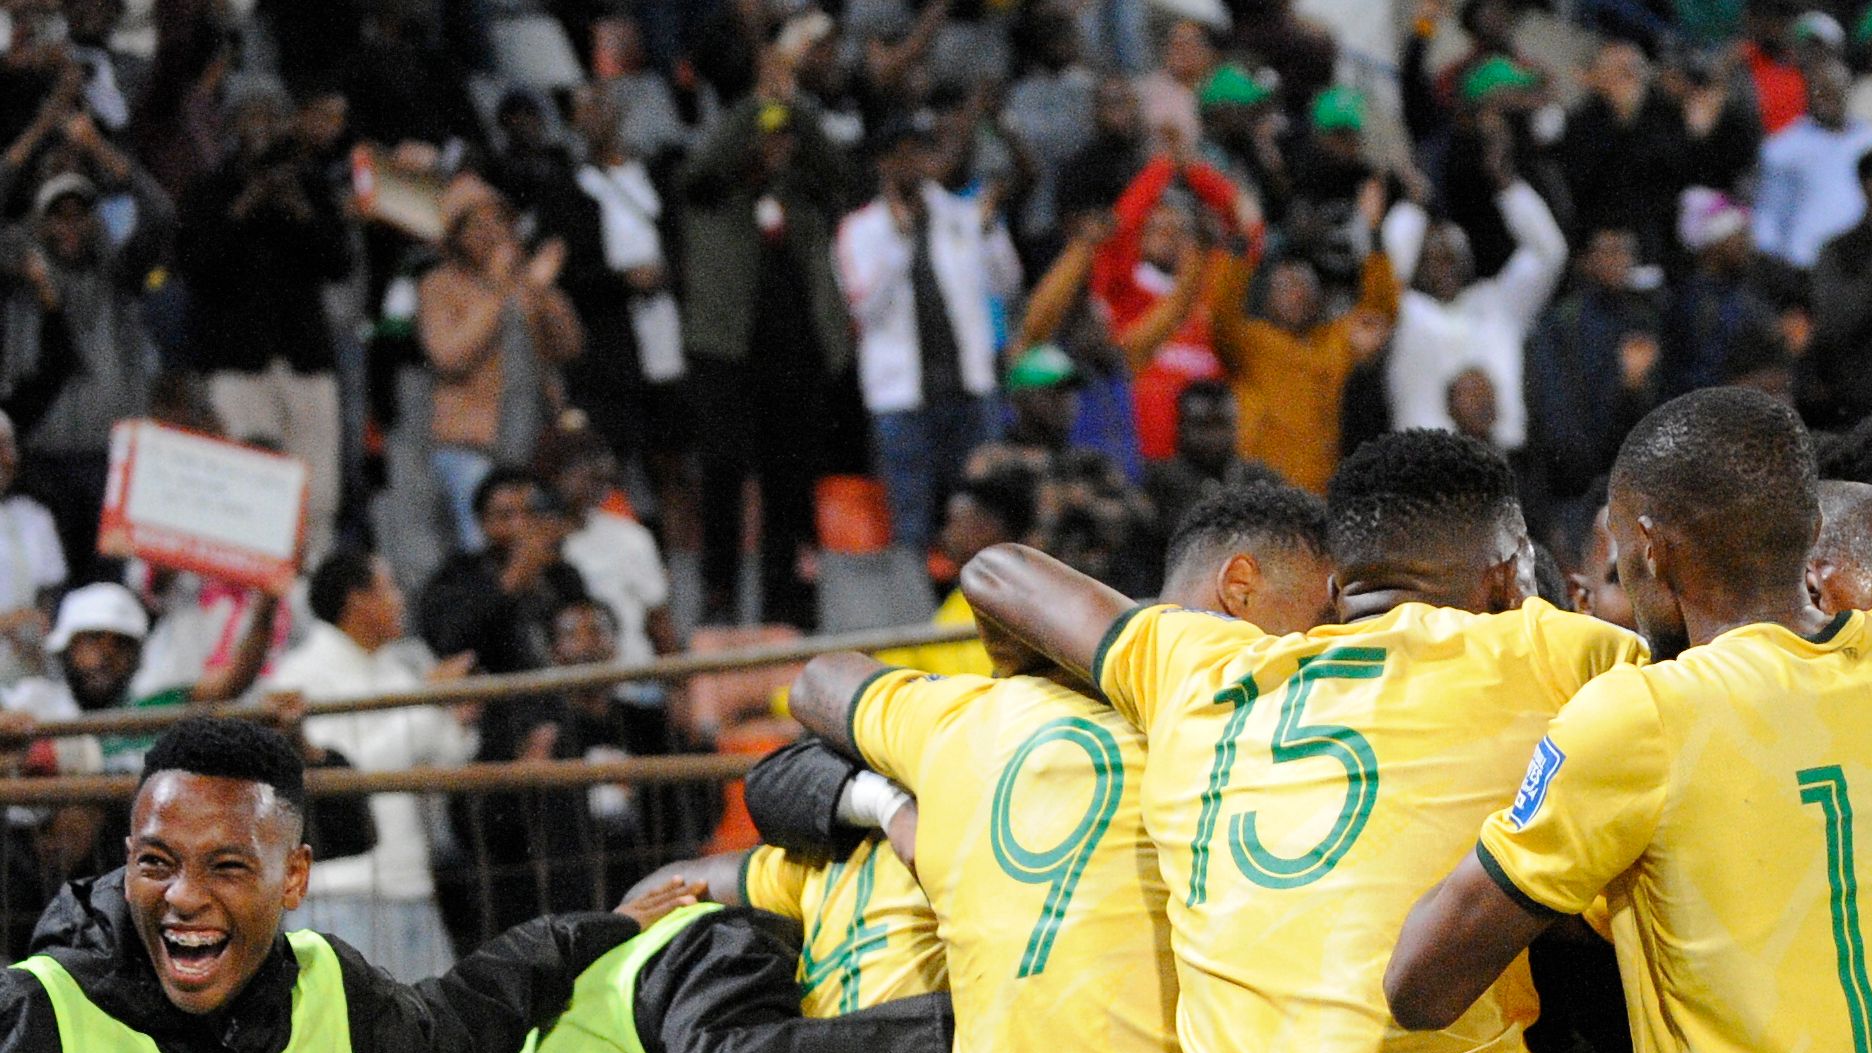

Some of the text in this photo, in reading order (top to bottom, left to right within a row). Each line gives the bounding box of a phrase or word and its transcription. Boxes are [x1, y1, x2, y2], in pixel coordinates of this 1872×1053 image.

[990, 716, 1124, 979] 9
[1186, 646, 1388, 908] 15
[801, 842, 889, 1016] 4
